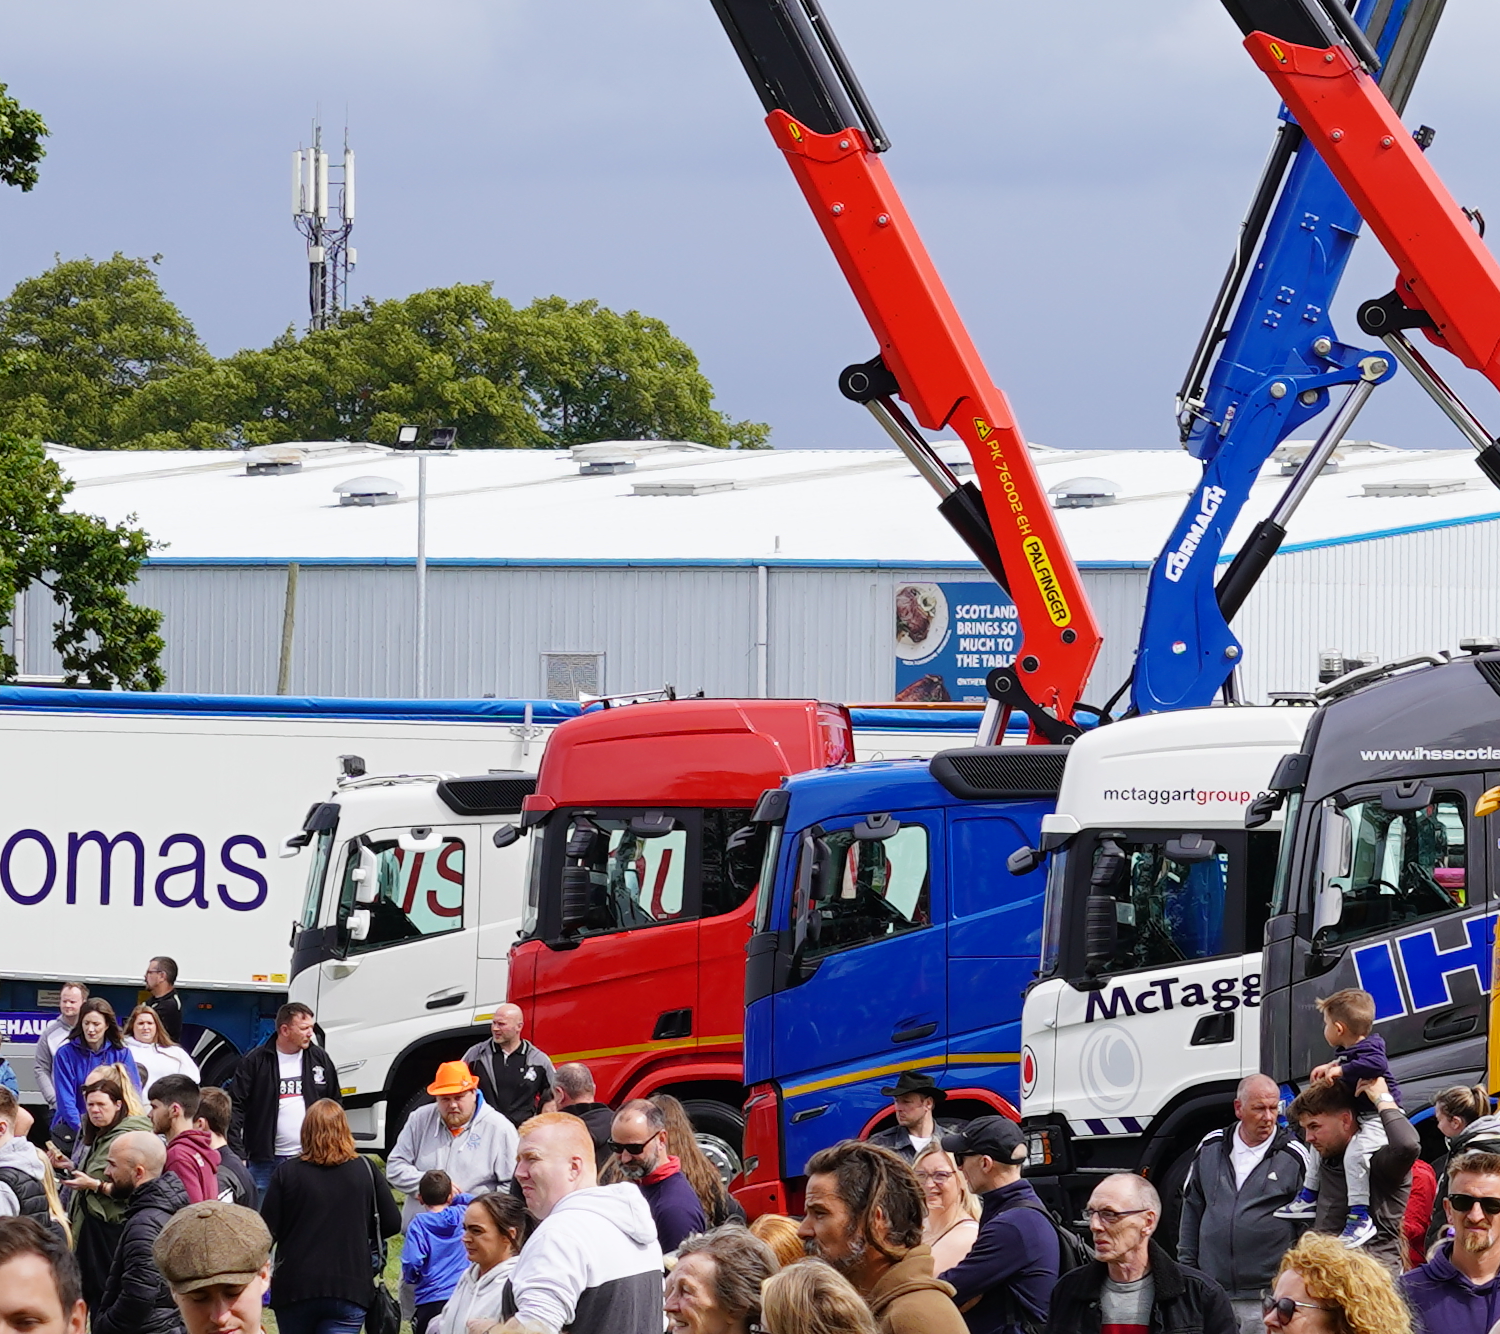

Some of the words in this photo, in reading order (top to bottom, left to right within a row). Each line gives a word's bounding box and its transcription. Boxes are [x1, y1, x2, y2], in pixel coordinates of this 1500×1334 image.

[986, 439, 1003, 462] PK
[994, 463, 1033, 536] 76002-EH
[1026, 541, 1067, 622] PALFINGER
[955, 605, 1019, 619] SCOTLAND
[956, 621, 1000, 635] BRINGS
[1001, 621, 1018, 635] SO
[959, 638, 996, 652] MUCH
[997, 638, 1014, 652] TO
[956, 654, 980, 668] THE
[1085, 973, 1262, 1024] McTagg
